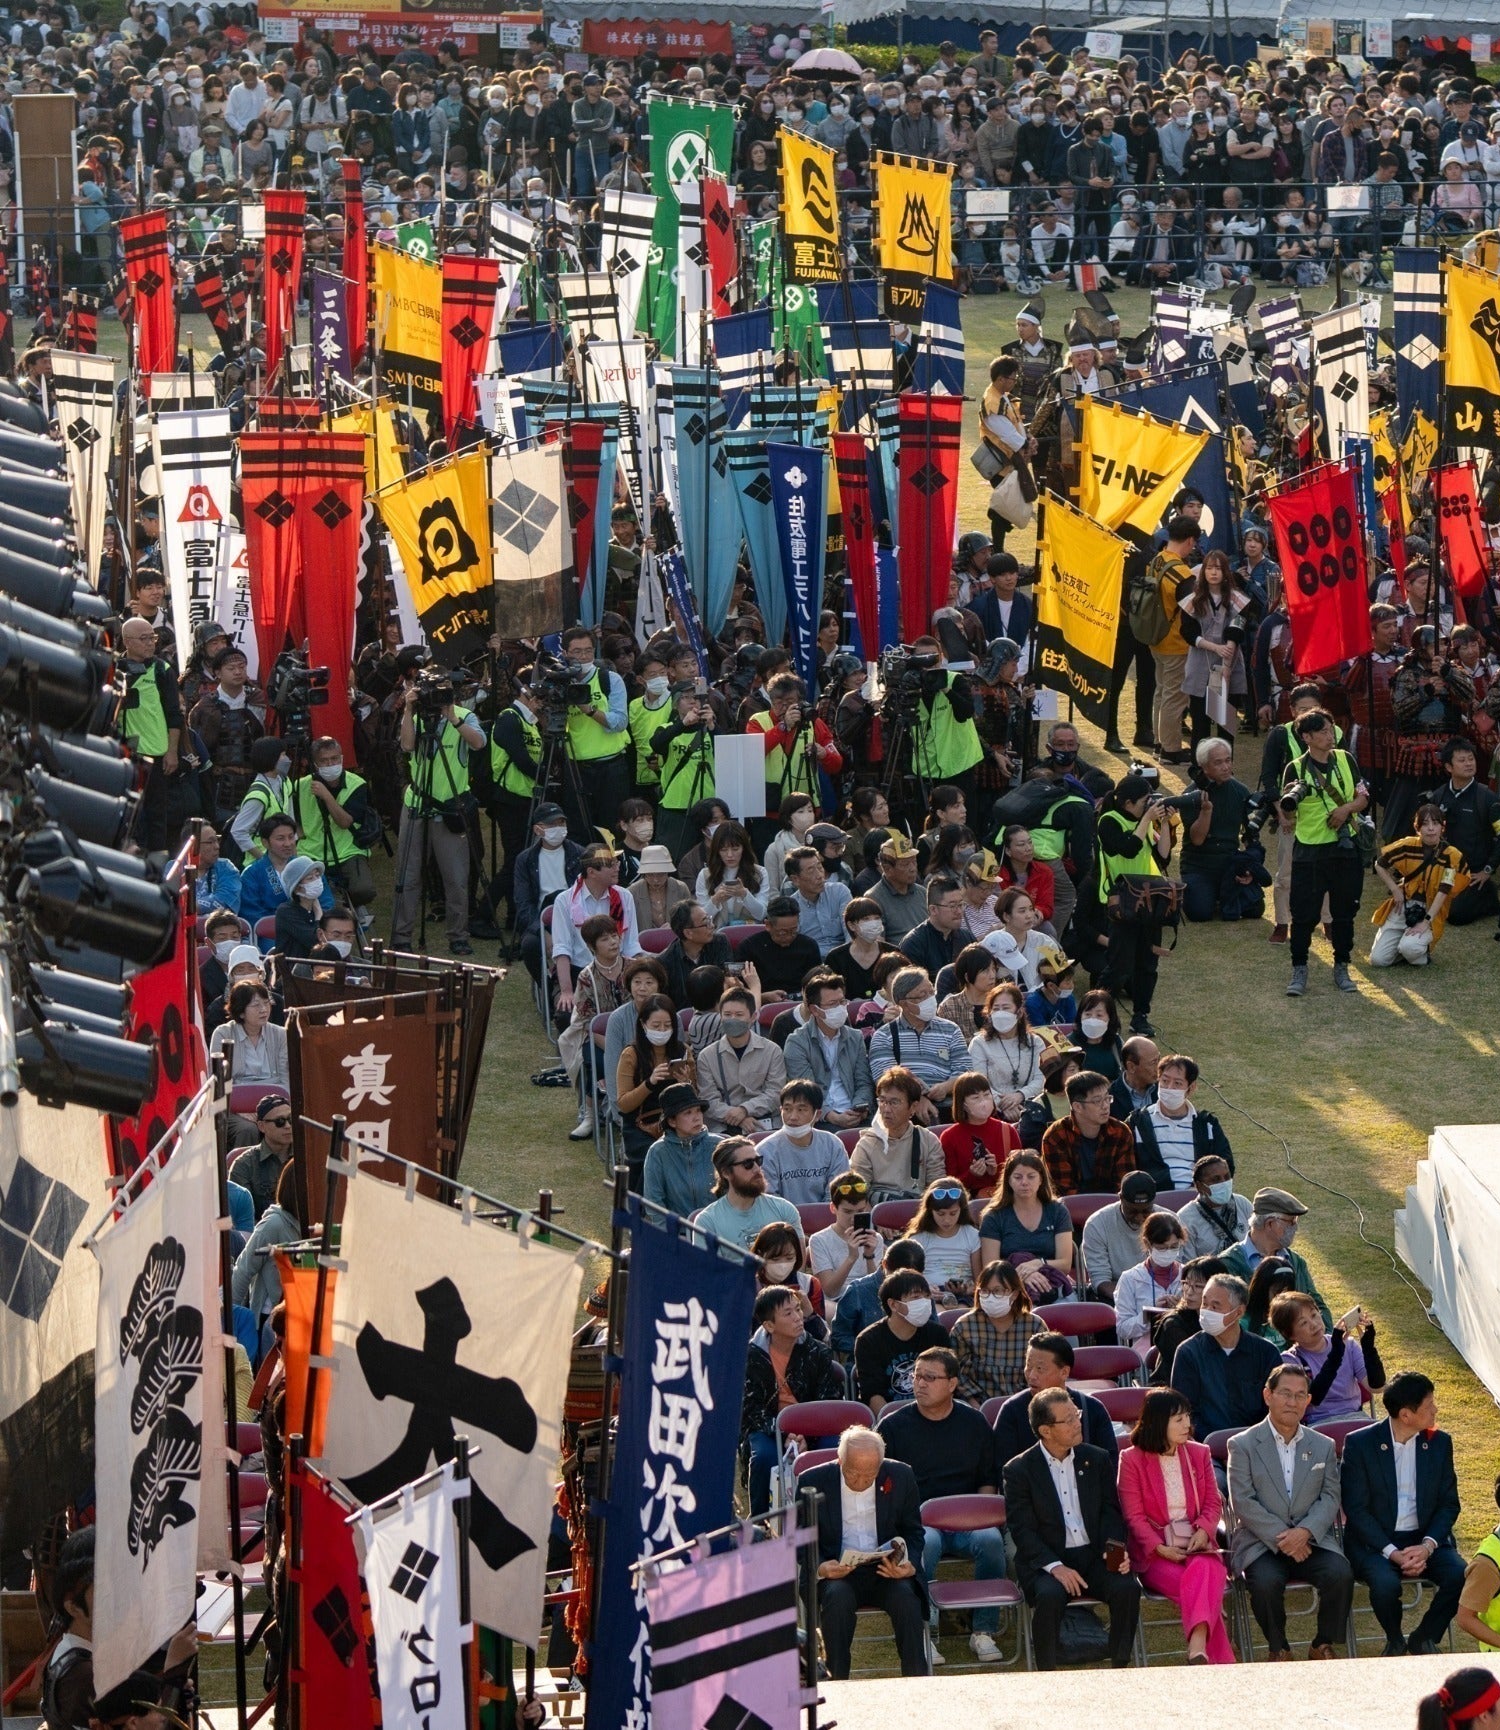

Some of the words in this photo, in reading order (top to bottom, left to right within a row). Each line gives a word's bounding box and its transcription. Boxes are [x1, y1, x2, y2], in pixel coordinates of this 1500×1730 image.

[606, 31, 658, 45] 株式会社
[338, 1275, 539, 1572] 大
